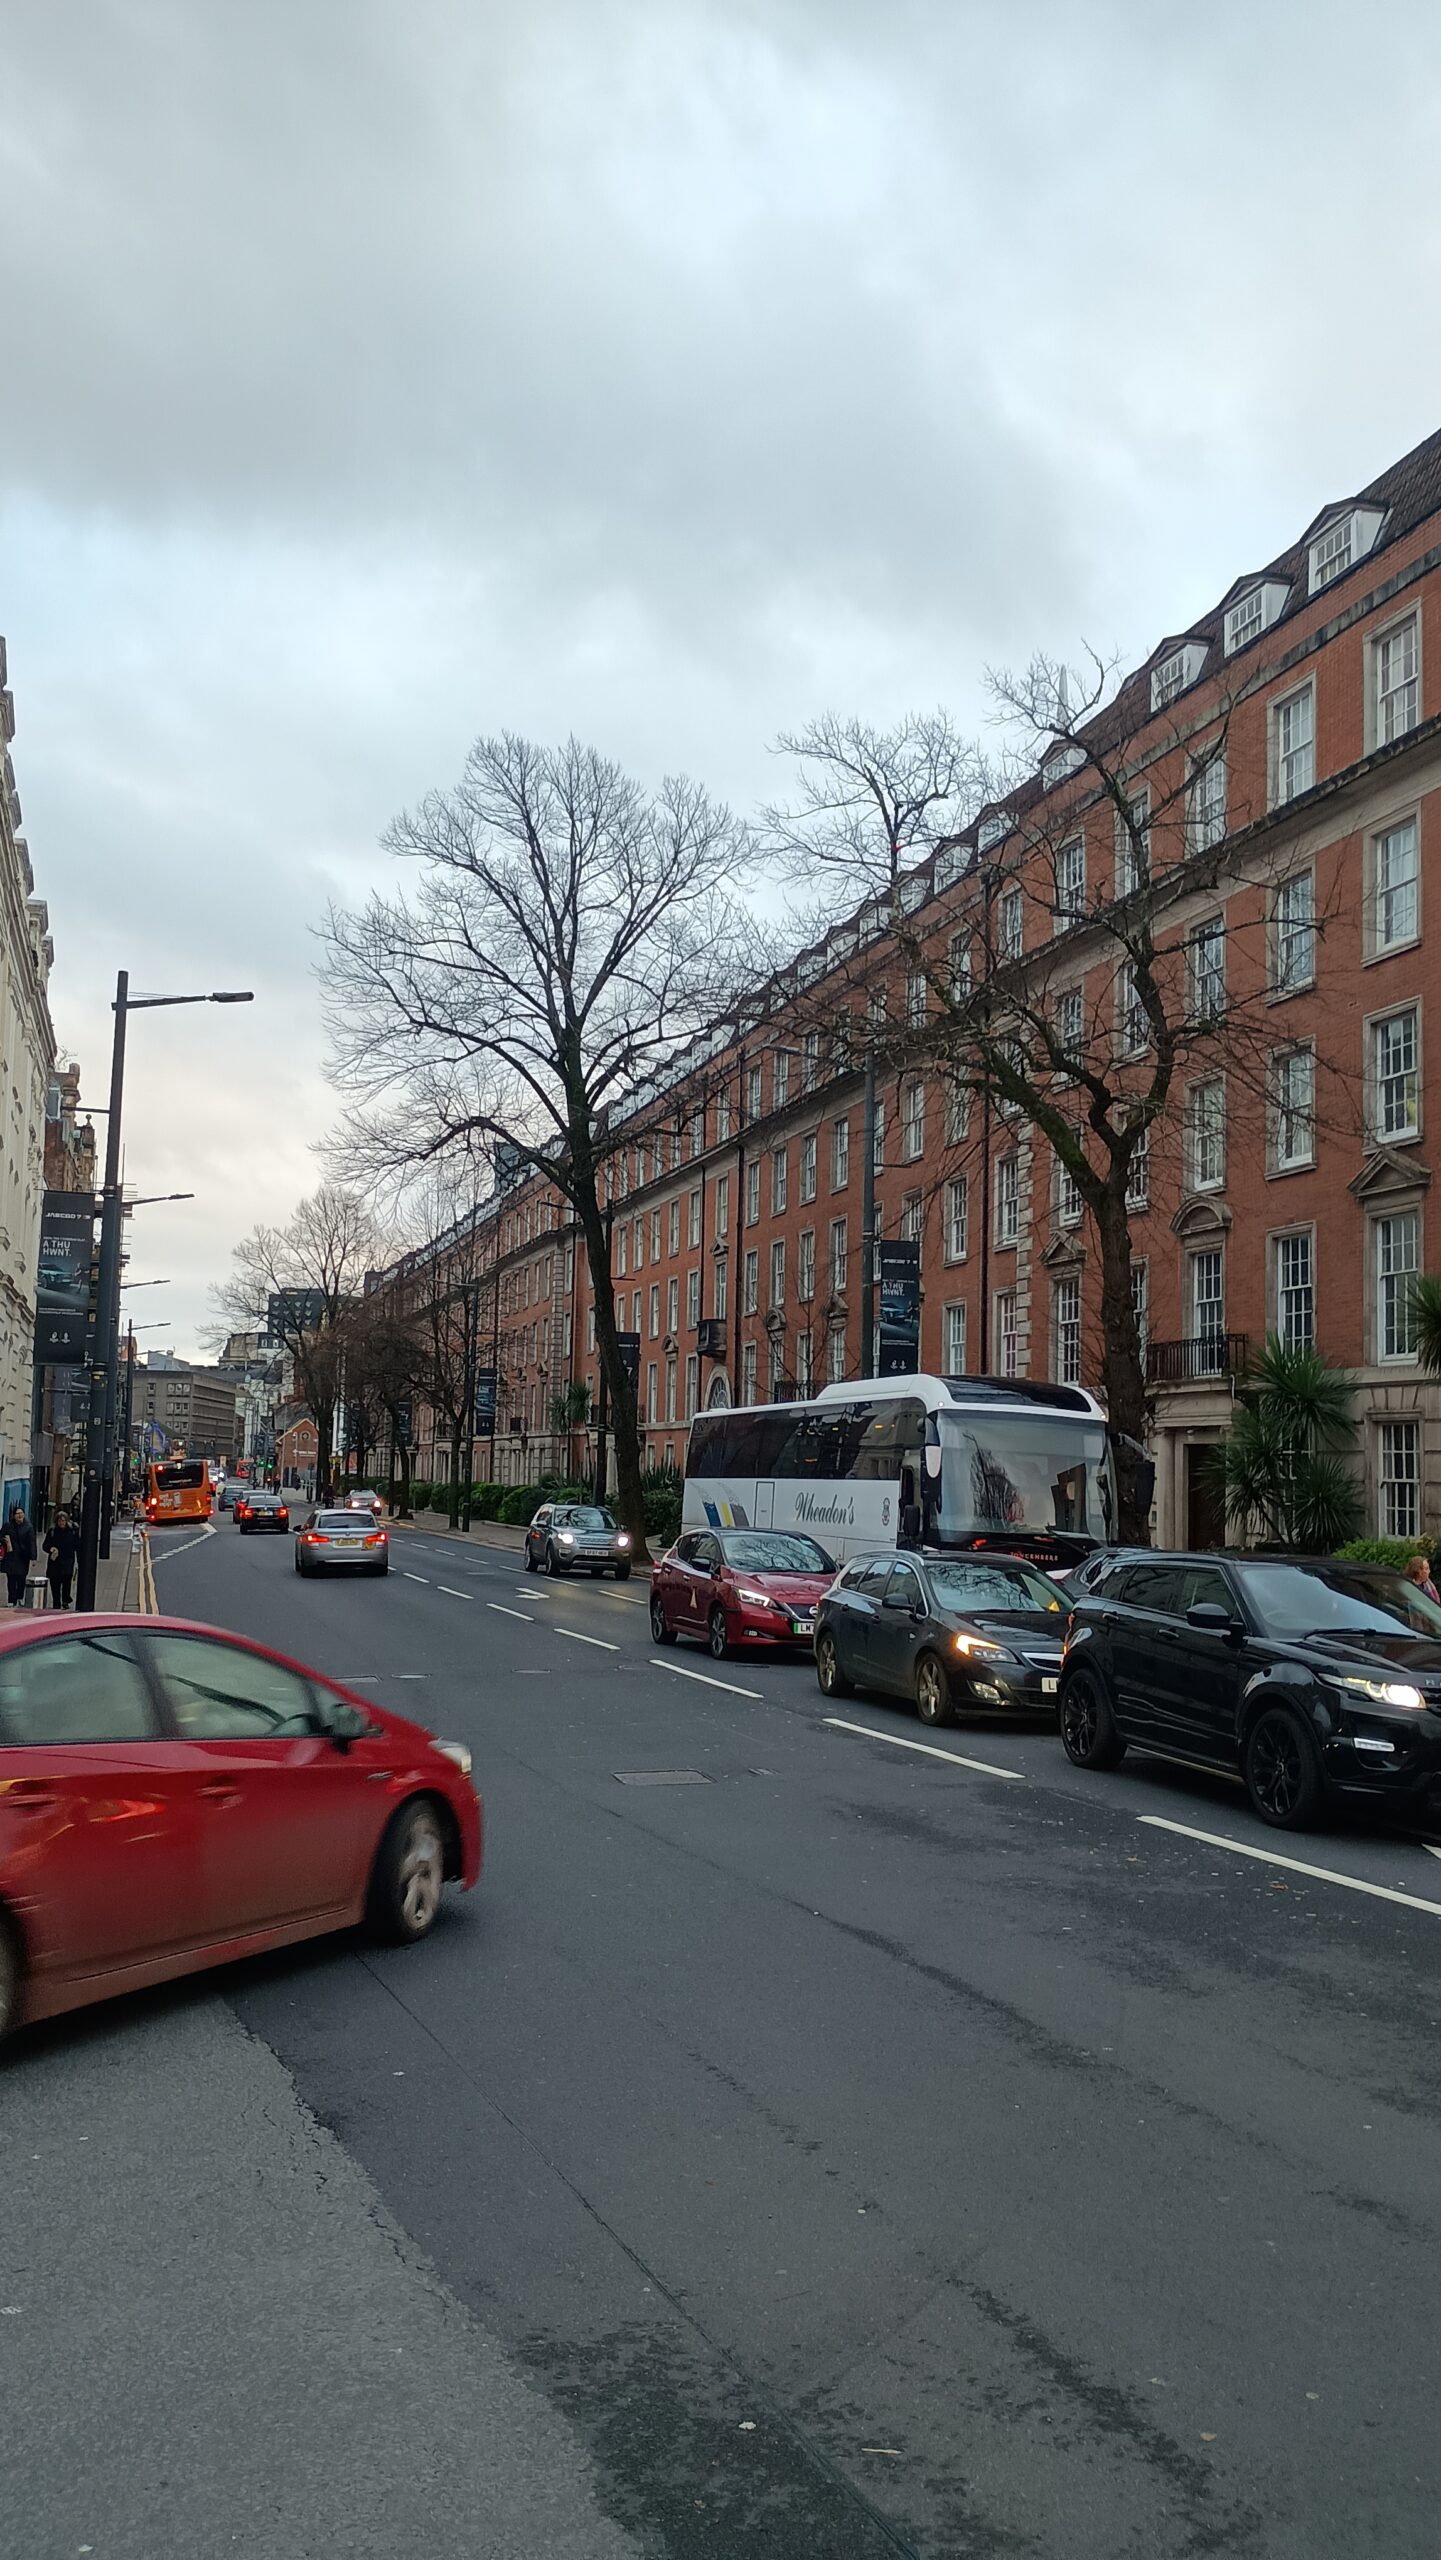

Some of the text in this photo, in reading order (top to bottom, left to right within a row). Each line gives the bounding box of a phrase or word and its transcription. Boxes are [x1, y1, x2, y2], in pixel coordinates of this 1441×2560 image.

[43, 1240, 71, 1249] A THU
[42, 1248, 72, 1257] HWNT.
[795, 1491, 855, 1526] Wheadon's
